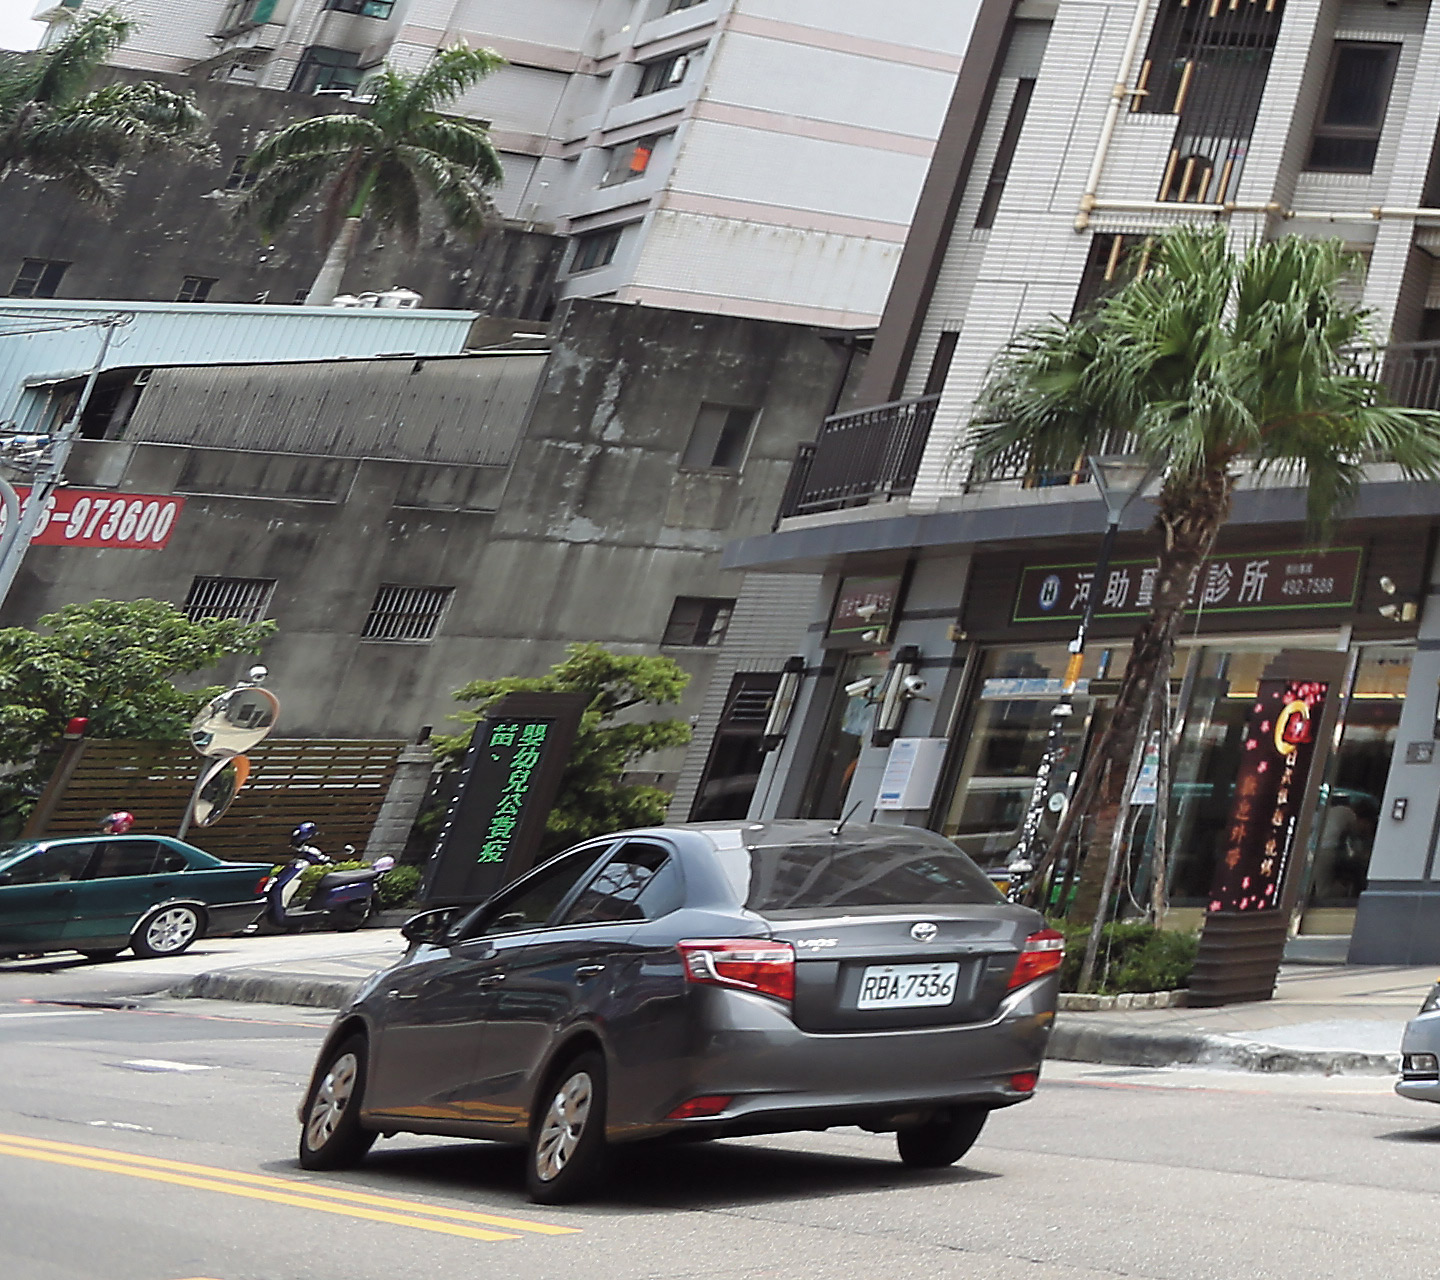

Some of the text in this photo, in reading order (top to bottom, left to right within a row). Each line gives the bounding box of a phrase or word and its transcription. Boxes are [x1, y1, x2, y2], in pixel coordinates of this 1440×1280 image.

[477, 724, 548, 863] 嬰幼兒公費疫
[862, 973, 955, 1001] RBA-7336
